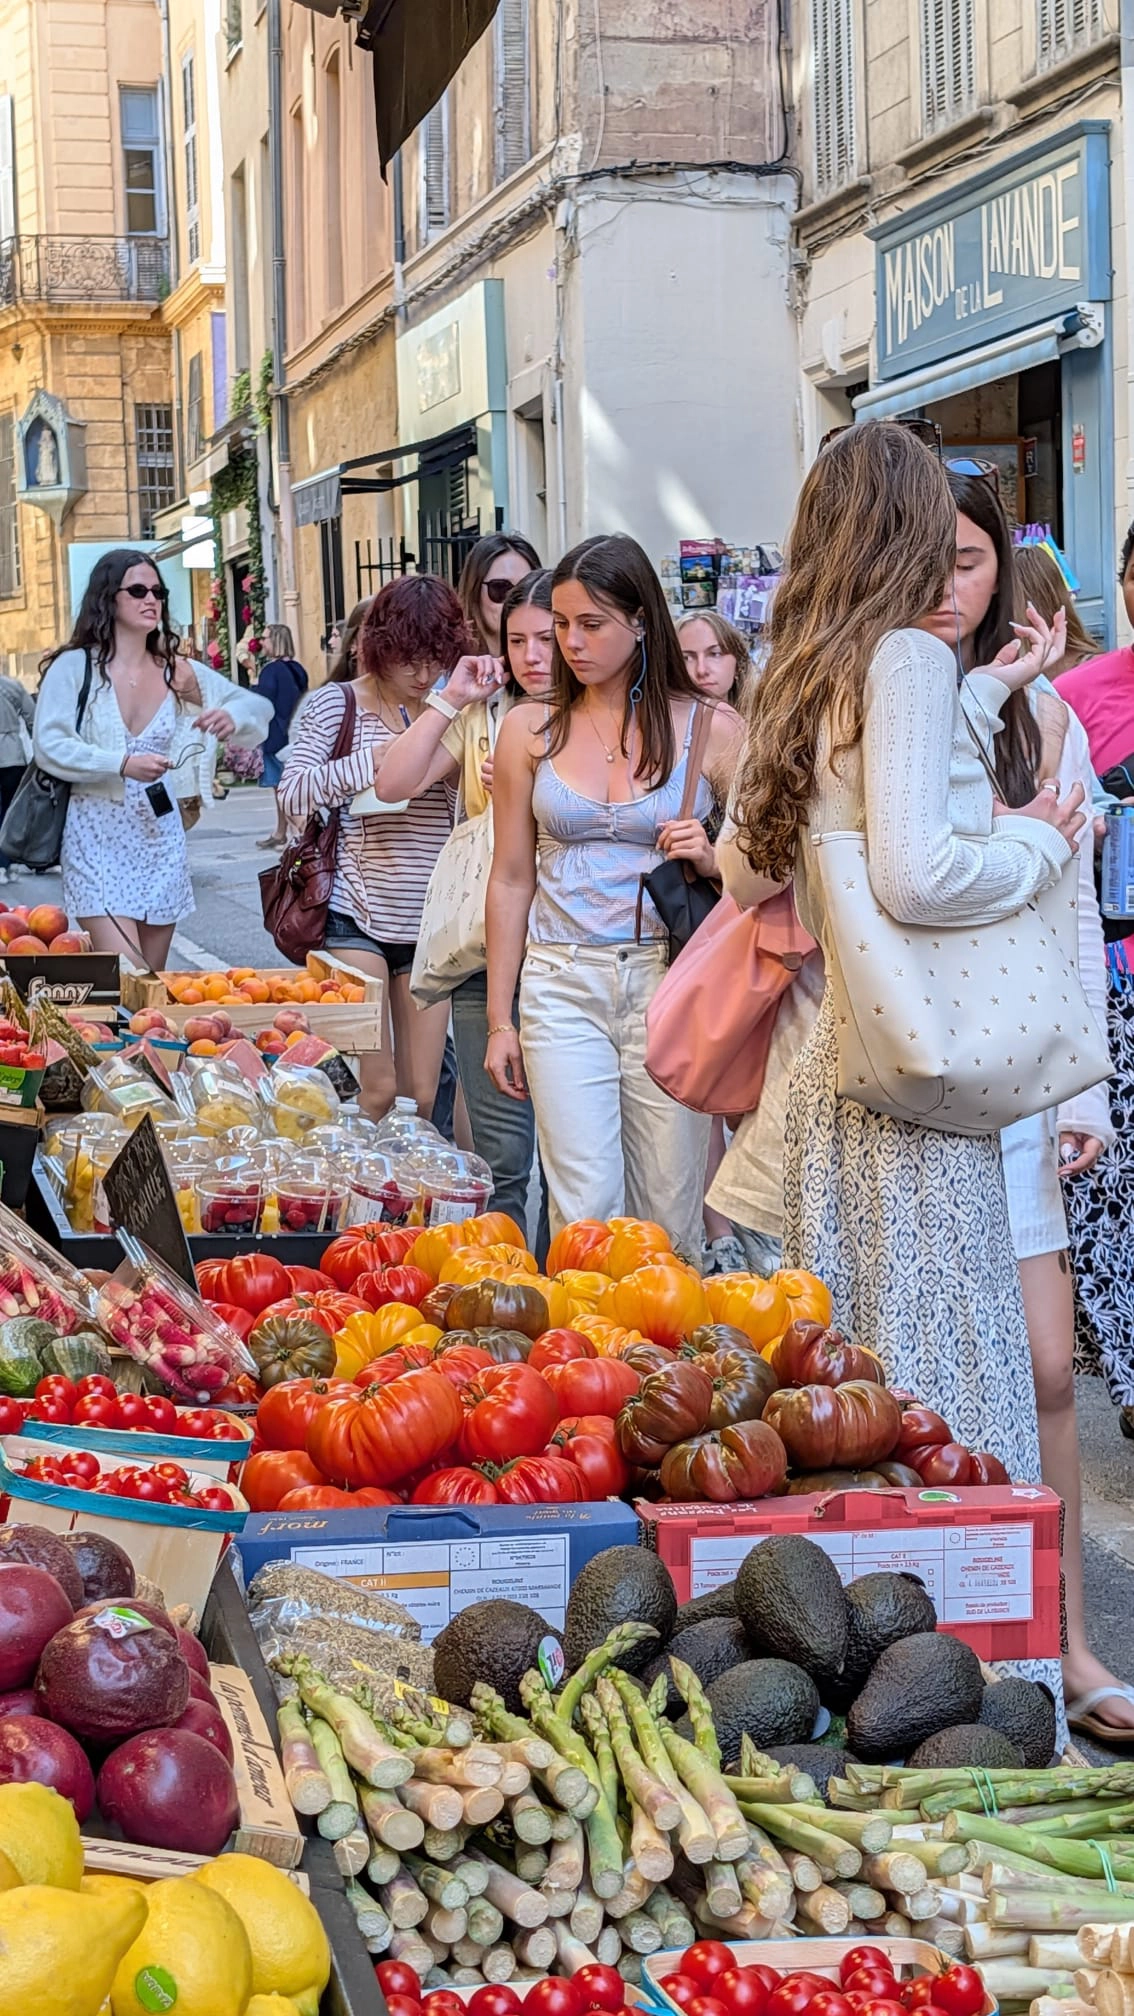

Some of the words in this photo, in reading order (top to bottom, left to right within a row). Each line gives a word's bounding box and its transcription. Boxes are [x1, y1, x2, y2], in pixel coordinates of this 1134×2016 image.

[884, 220, 955, 356] MAISON
[955, 286, 968, 320] DE
[969, 280, 981, 314] LA
[981, 158, 1081, 309] LAVANDE
[360, 1578, 378, 1588] CAT
